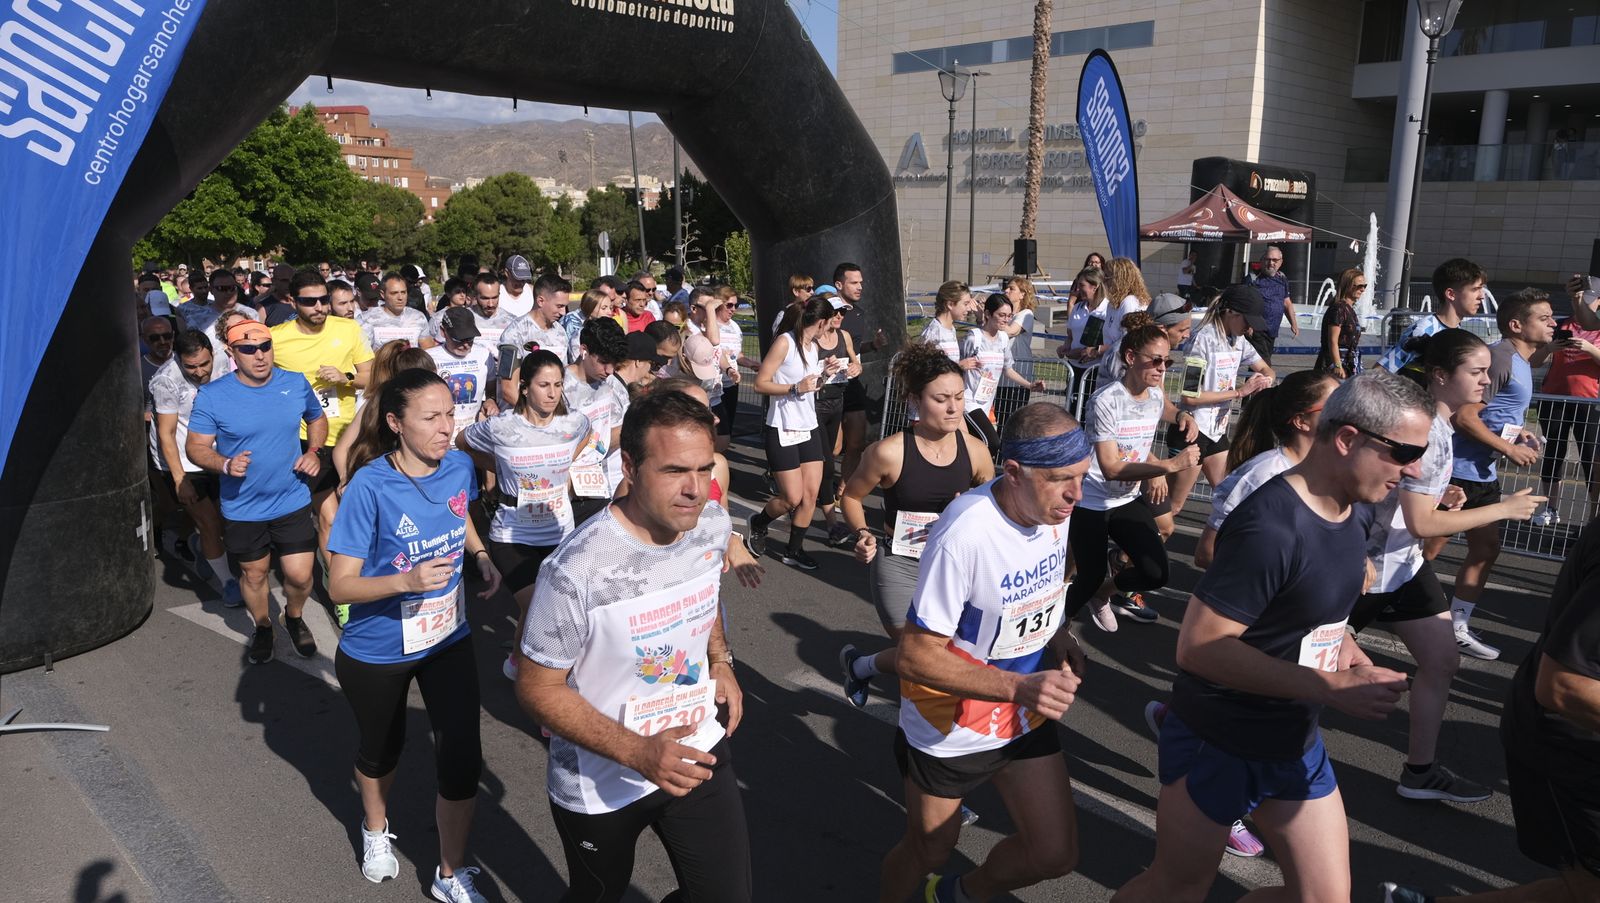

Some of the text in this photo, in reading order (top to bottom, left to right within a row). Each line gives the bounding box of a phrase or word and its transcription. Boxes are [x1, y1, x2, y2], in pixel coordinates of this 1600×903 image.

[673, 9, 734, 33] deportivo
[84, 0, 194, 185] centrohogarsanche
[576, 472, 605, 486] 1038
[526, 496, 563, 514] 1185
[396, 526, 419, 536] ALTEA
[408, 541, 420, 555] II
[421, 532, 449, 550] Runner
[434, 541, 450, 557] azul
[640, 600, 682, 625] CARRERA
[682, 593, 697, 609] SIN
[1016, 604, 1056, 638] 137
[638, 705, 706, 737] 1230
